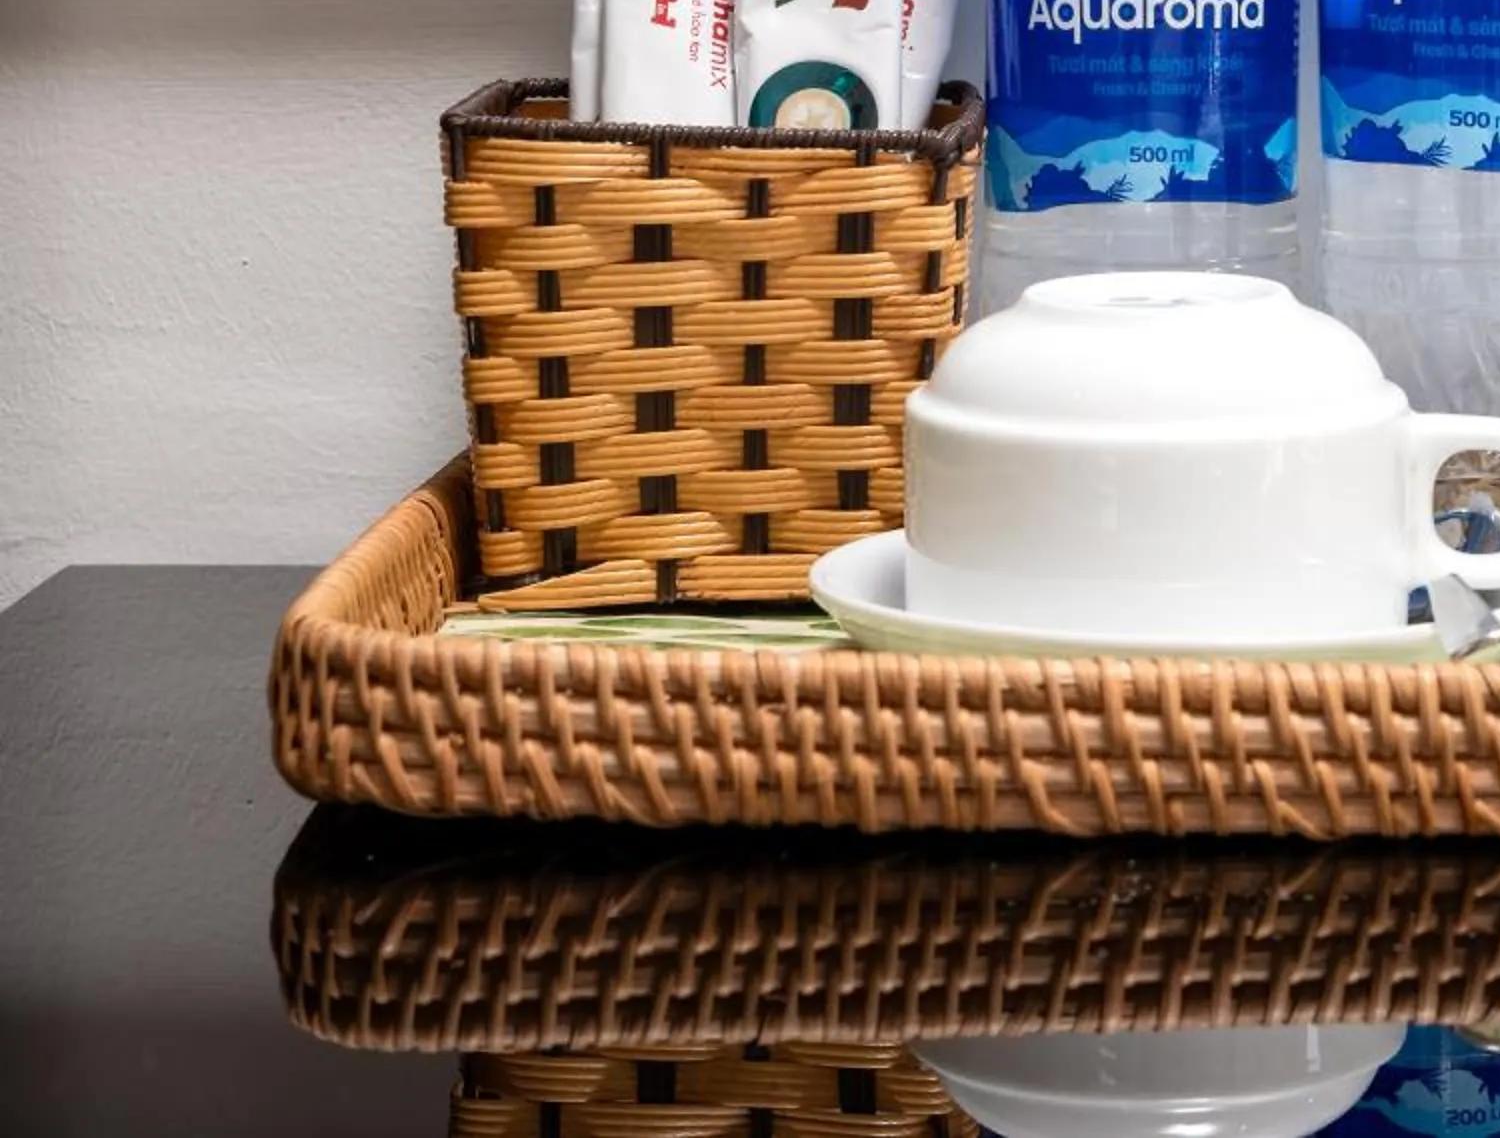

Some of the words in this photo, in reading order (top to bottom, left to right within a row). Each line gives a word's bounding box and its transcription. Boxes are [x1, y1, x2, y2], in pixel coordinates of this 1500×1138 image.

[1450, 111, 1491, 128] 500
[1129, 146, 1167, 163] 500
[1171, 144, 1195, 163] ml
